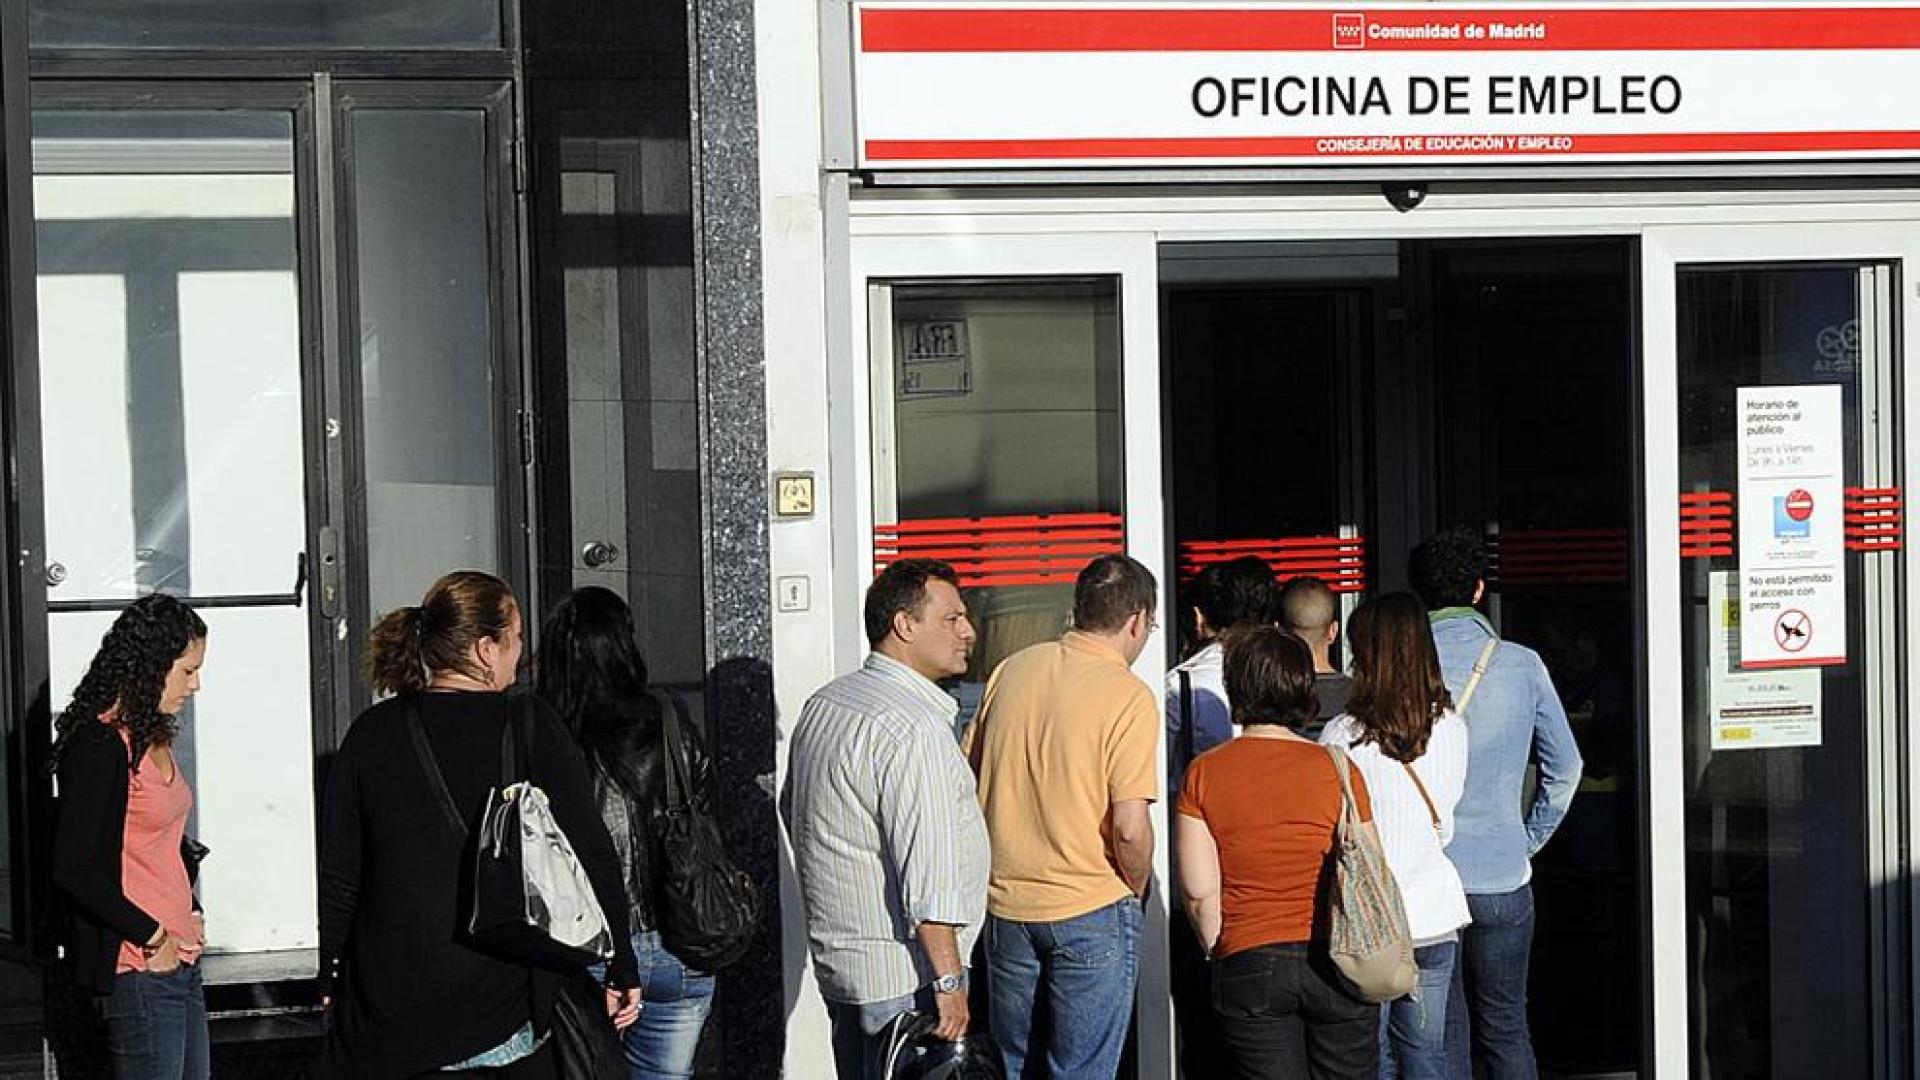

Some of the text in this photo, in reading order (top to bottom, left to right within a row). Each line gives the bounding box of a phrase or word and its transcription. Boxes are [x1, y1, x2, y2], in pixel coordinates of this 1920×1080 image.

[1368, 23, 1545, 39] Comunidad de Madrid
[1191, 74, 1682, 117] OFICINA DE EMPLEO
[1316, 134, 1573, 152] CONSEJERÍA DE EDUCACIÓN Y EMPLEO
[1786, 399, 1799, 410] de
[1746, 412, 1790, 423] atención
[1749, 575, 1763, 585] No
[1787, 573, 1834, 585] permitido
[1760, 588, 1795, 597] acceso
[1797, 586, 1816, 596] con
[1749, 602, 1781, 612] perros
